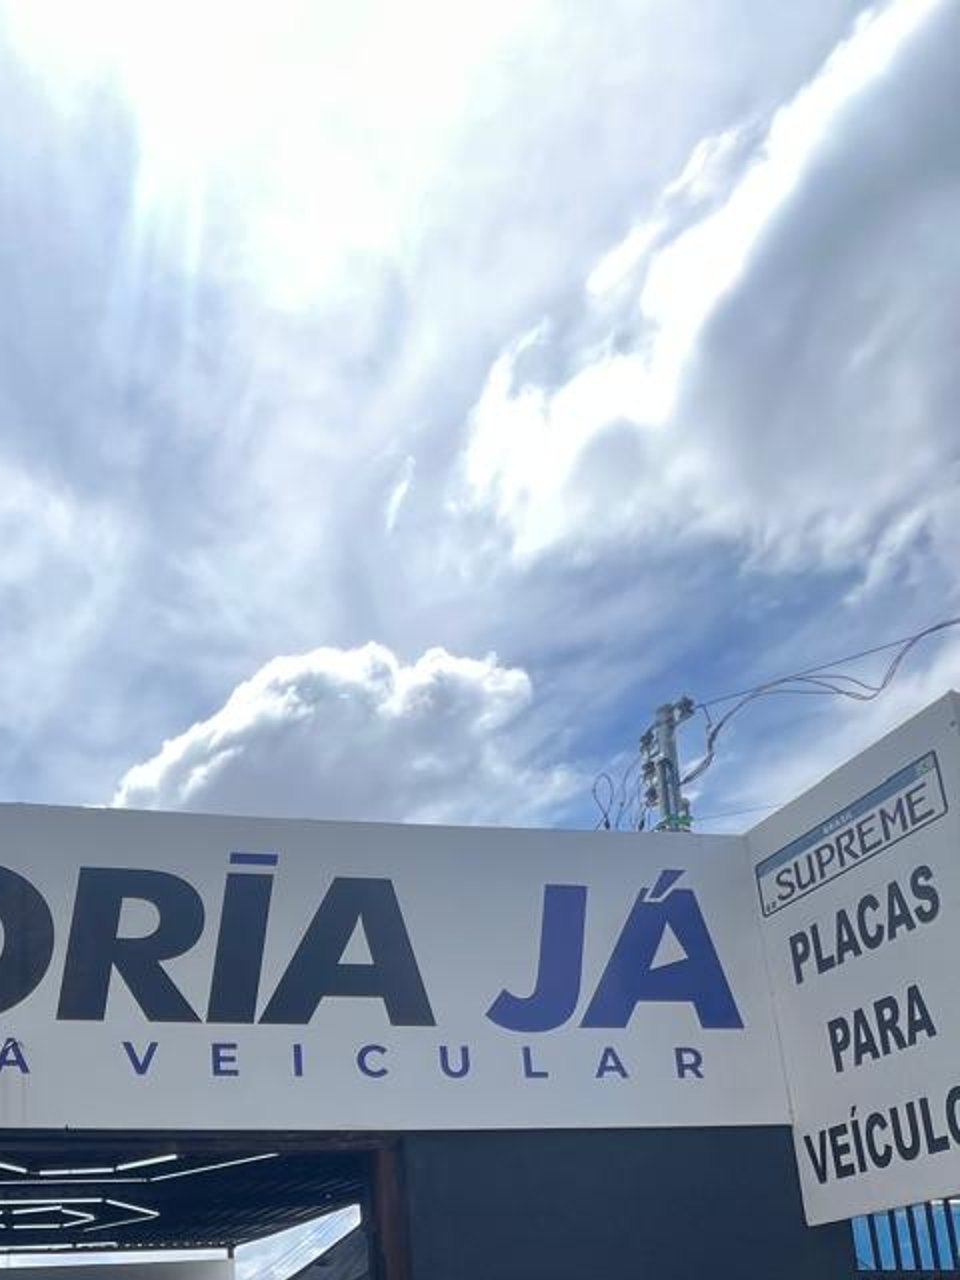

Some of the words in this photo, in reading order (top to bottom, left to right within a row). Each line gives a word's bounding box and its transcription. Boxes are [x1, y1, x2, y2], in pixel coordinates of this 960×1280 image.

[775, 782, 935, 902] SUPREME
[485, 869, 745, 1033] JÁ
[789, 865, 940, 985] PLACAS
[123, 1041, 705, 1079] VEICULAR
[827, 984, 938, 1073] PARA
